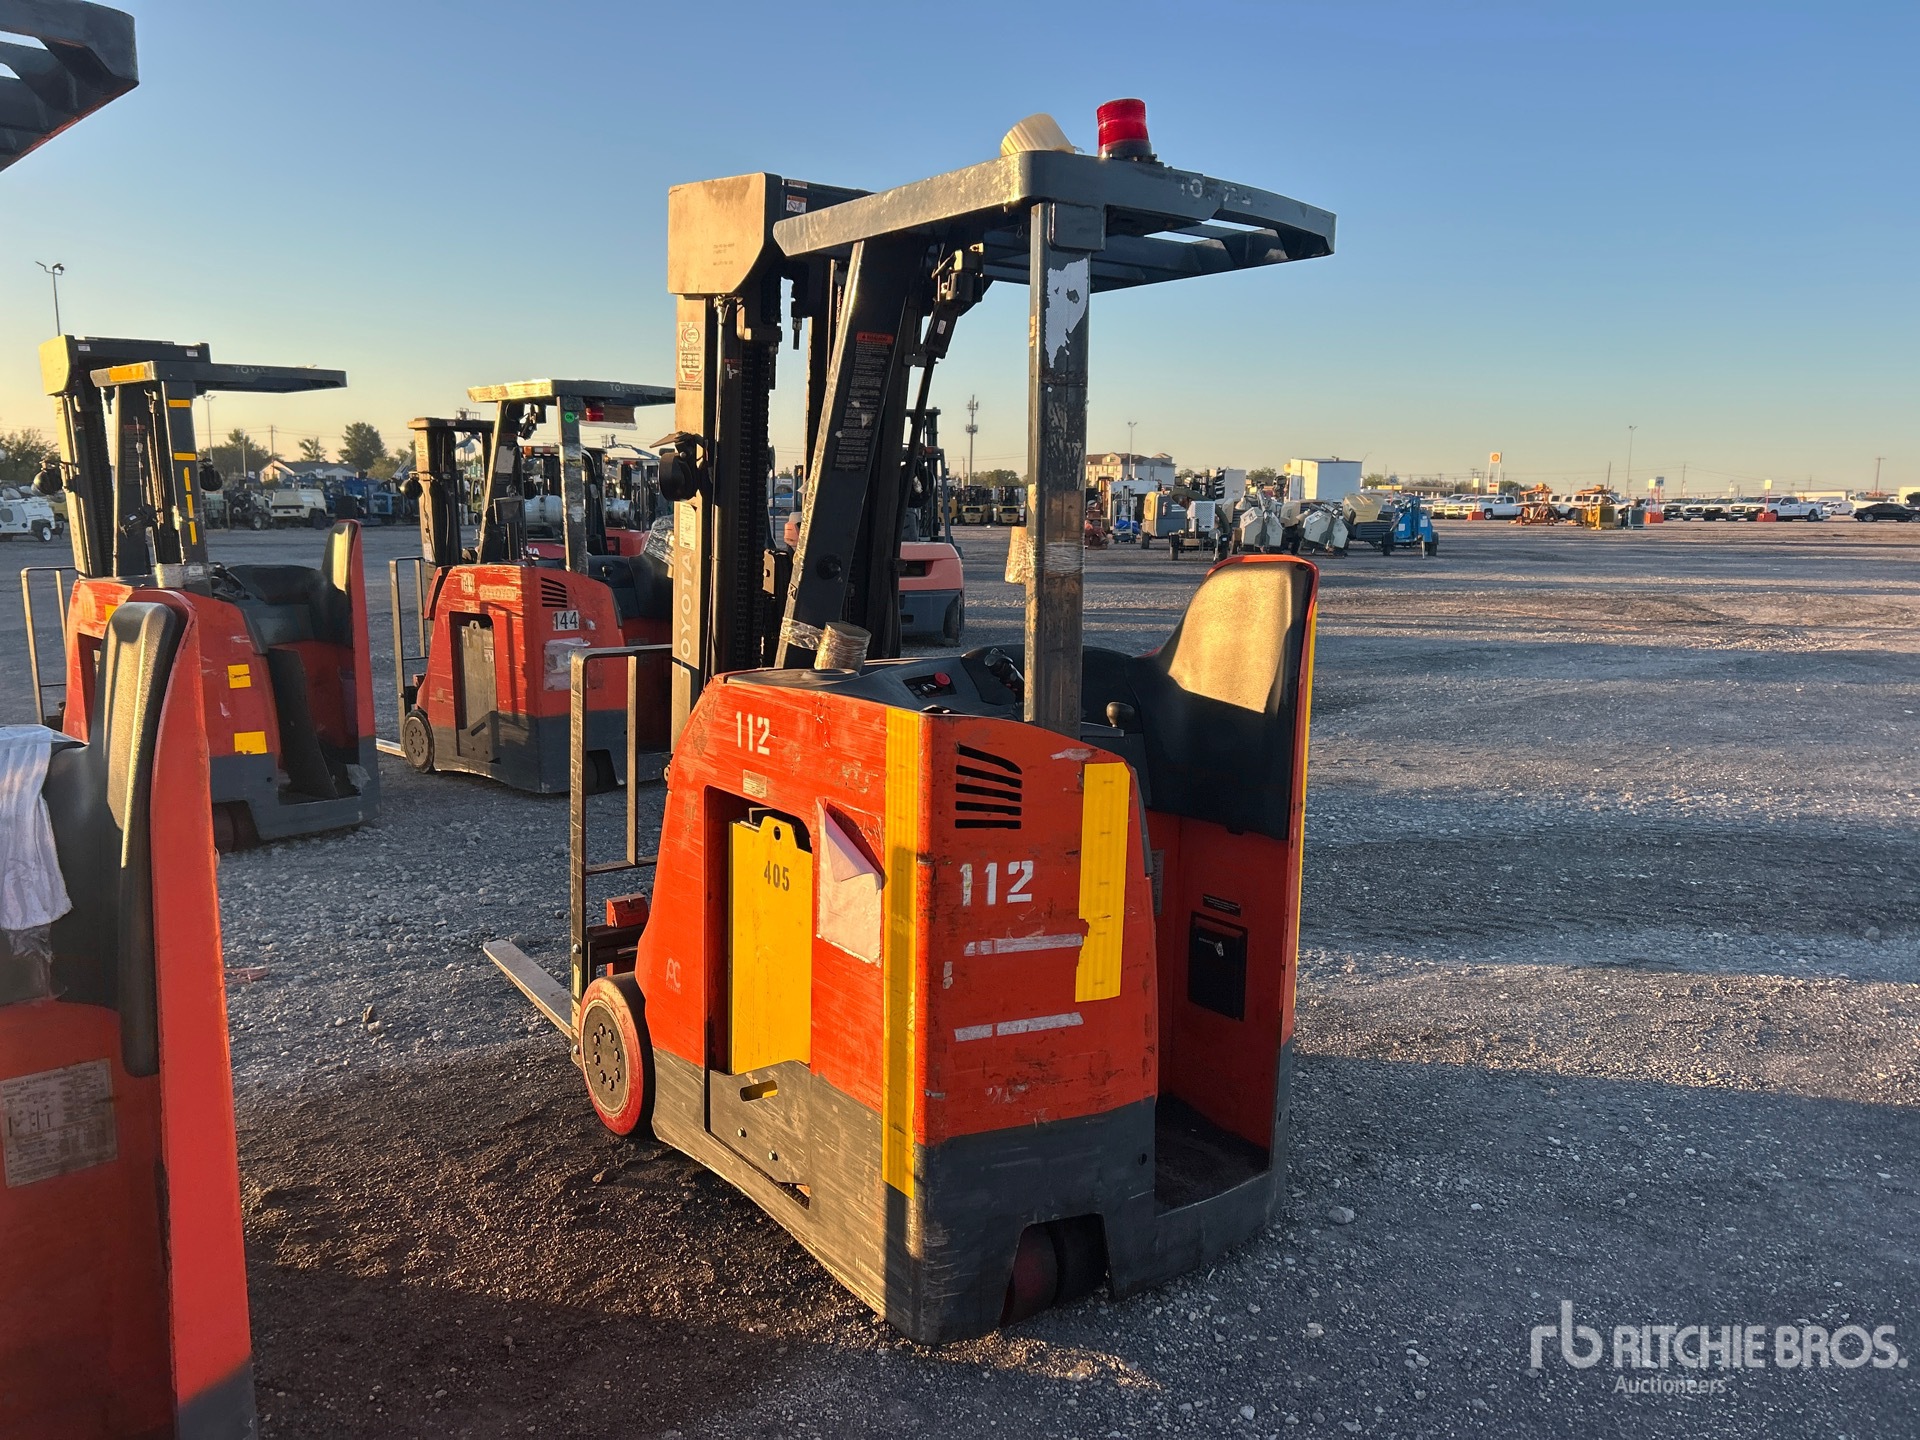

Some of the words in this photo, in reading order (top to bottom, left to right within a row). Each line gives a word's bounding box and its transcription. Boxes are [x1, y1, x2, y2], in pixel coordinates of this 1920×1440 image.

[553, 611, 578, 629] 144
[679, 553, 693, 680] TOYOTA
[735, 711, 771, 756] 112
[763, 860, 790, 892] 405
[959, 859, 1035, 908] 112
